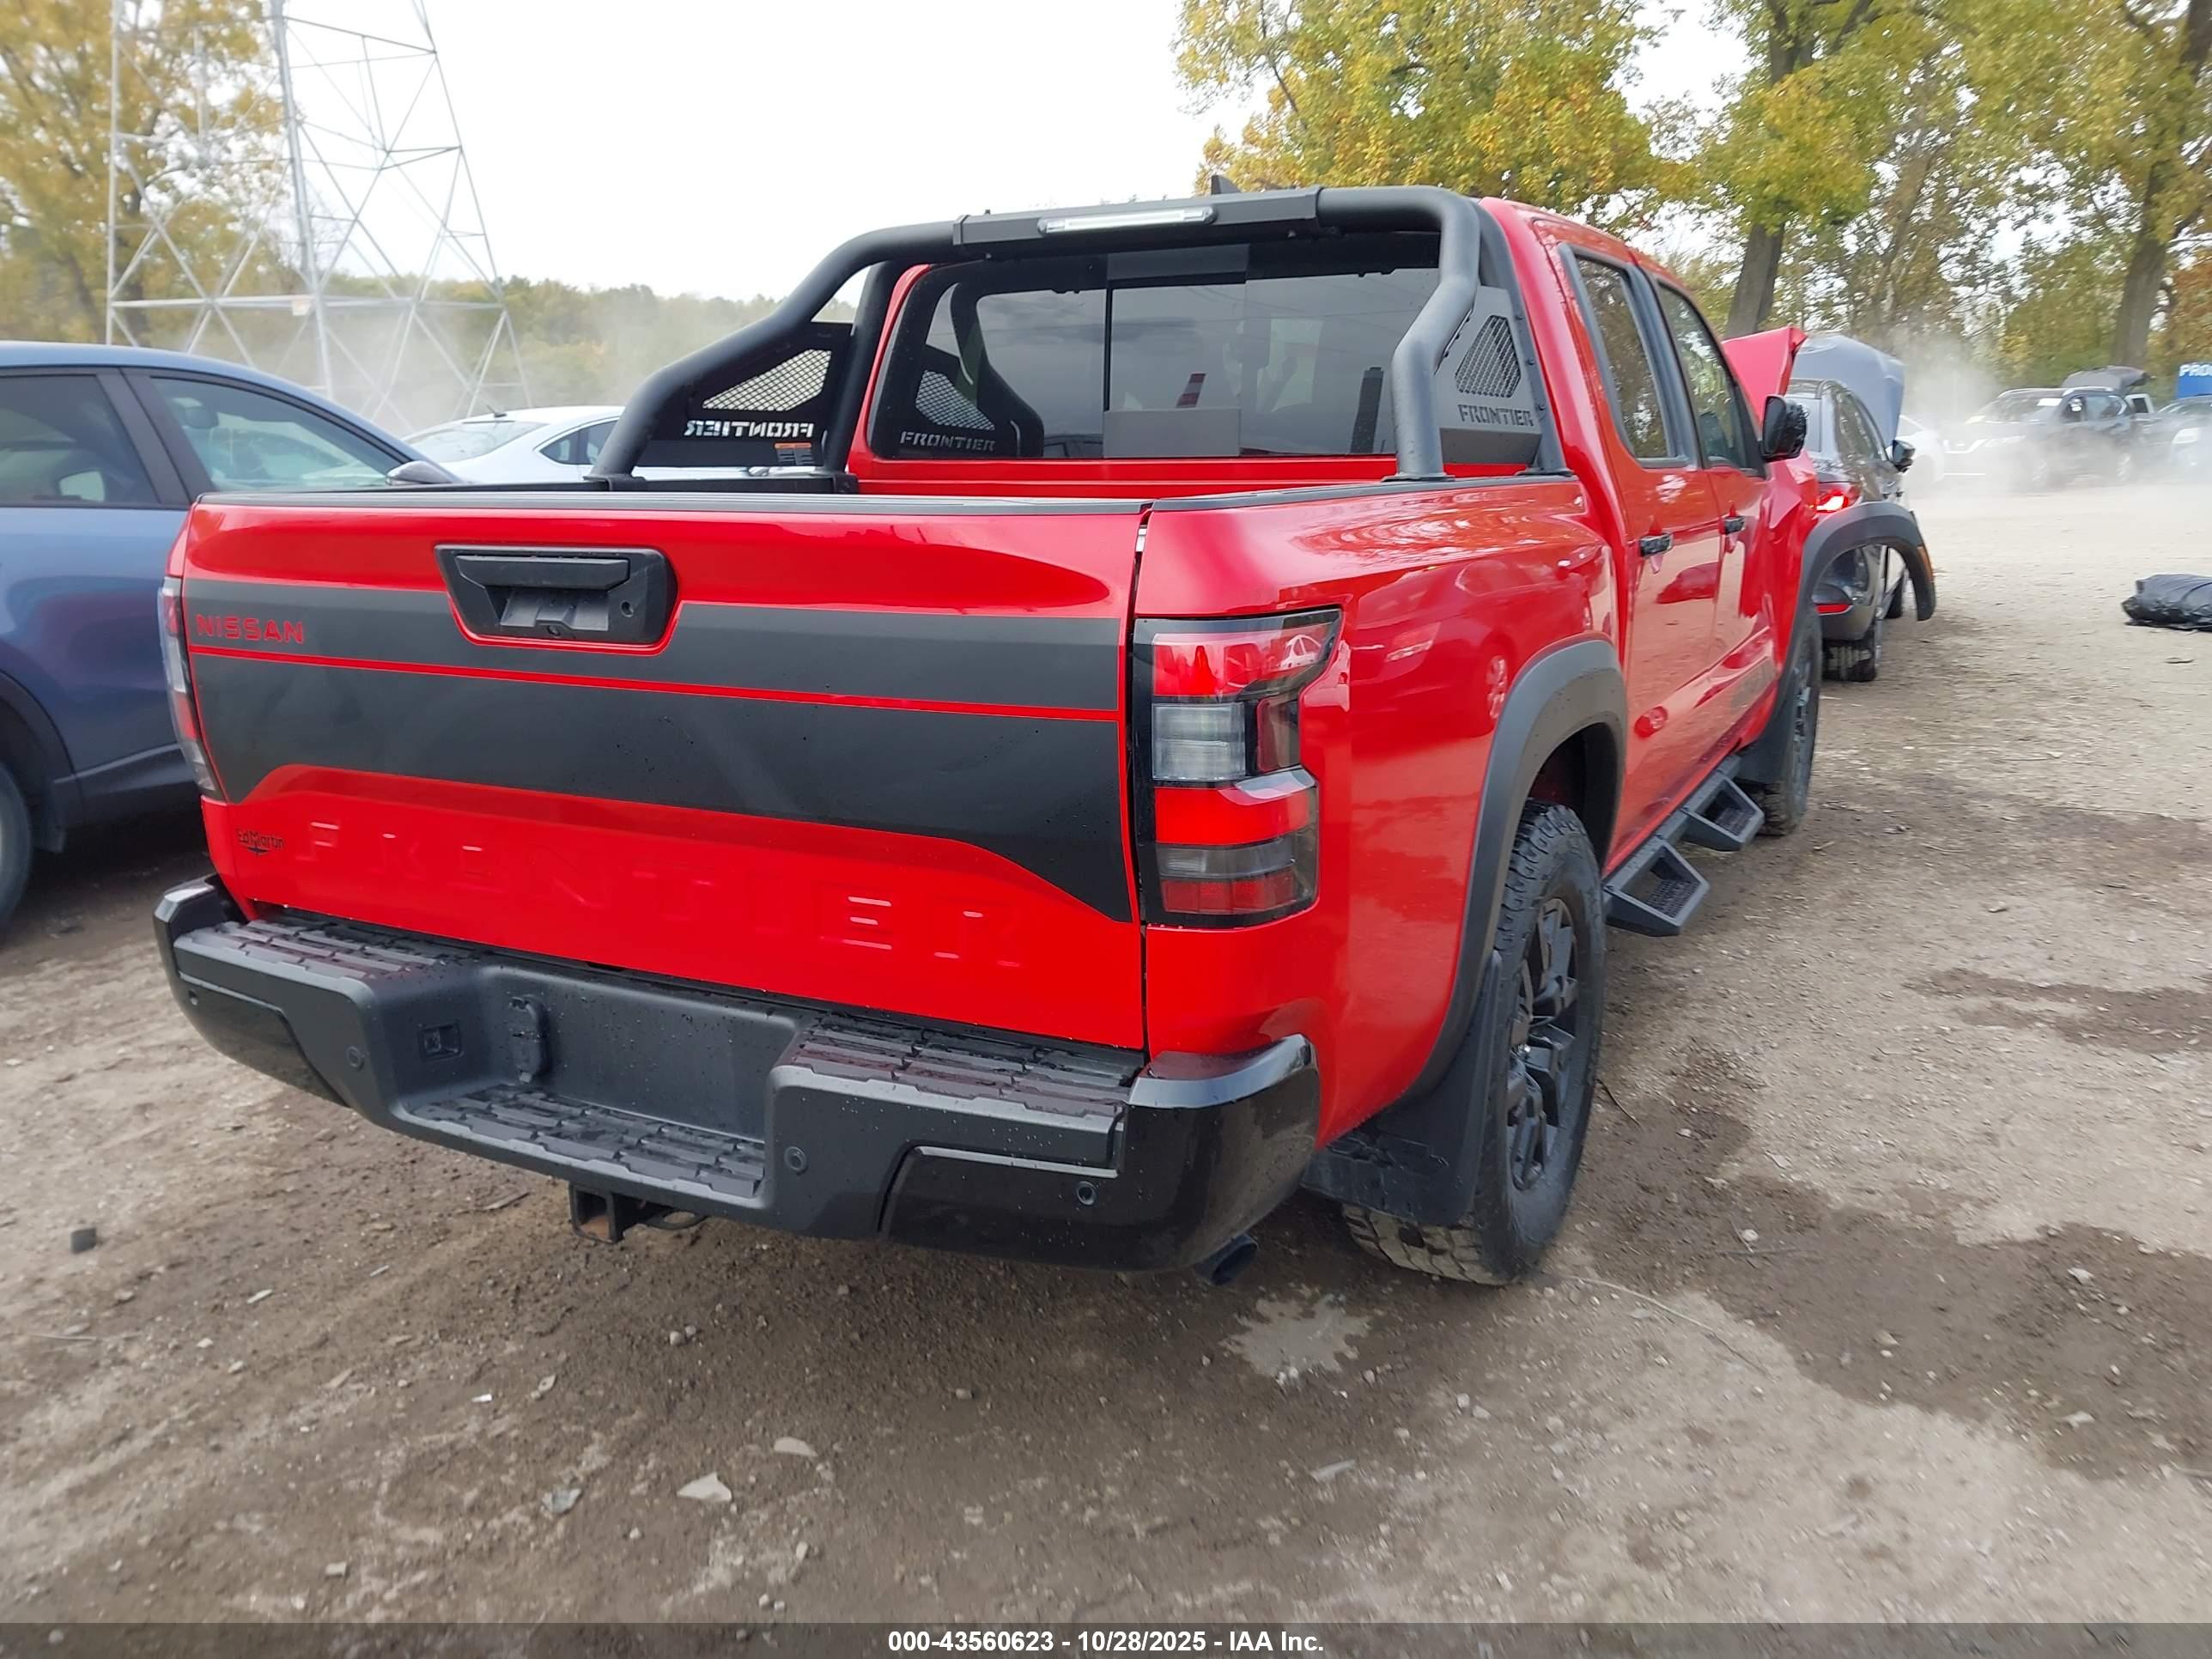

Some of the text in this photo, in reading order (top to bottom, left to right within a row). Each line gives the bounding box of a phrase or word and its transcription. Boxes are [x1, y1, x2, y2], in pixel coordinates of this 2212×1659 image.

[1457, 404, 1534, 427] FRONTIER
[899, 430, 996, 452] FRONTIER
[195, 613, 305, 644] NISSAN
